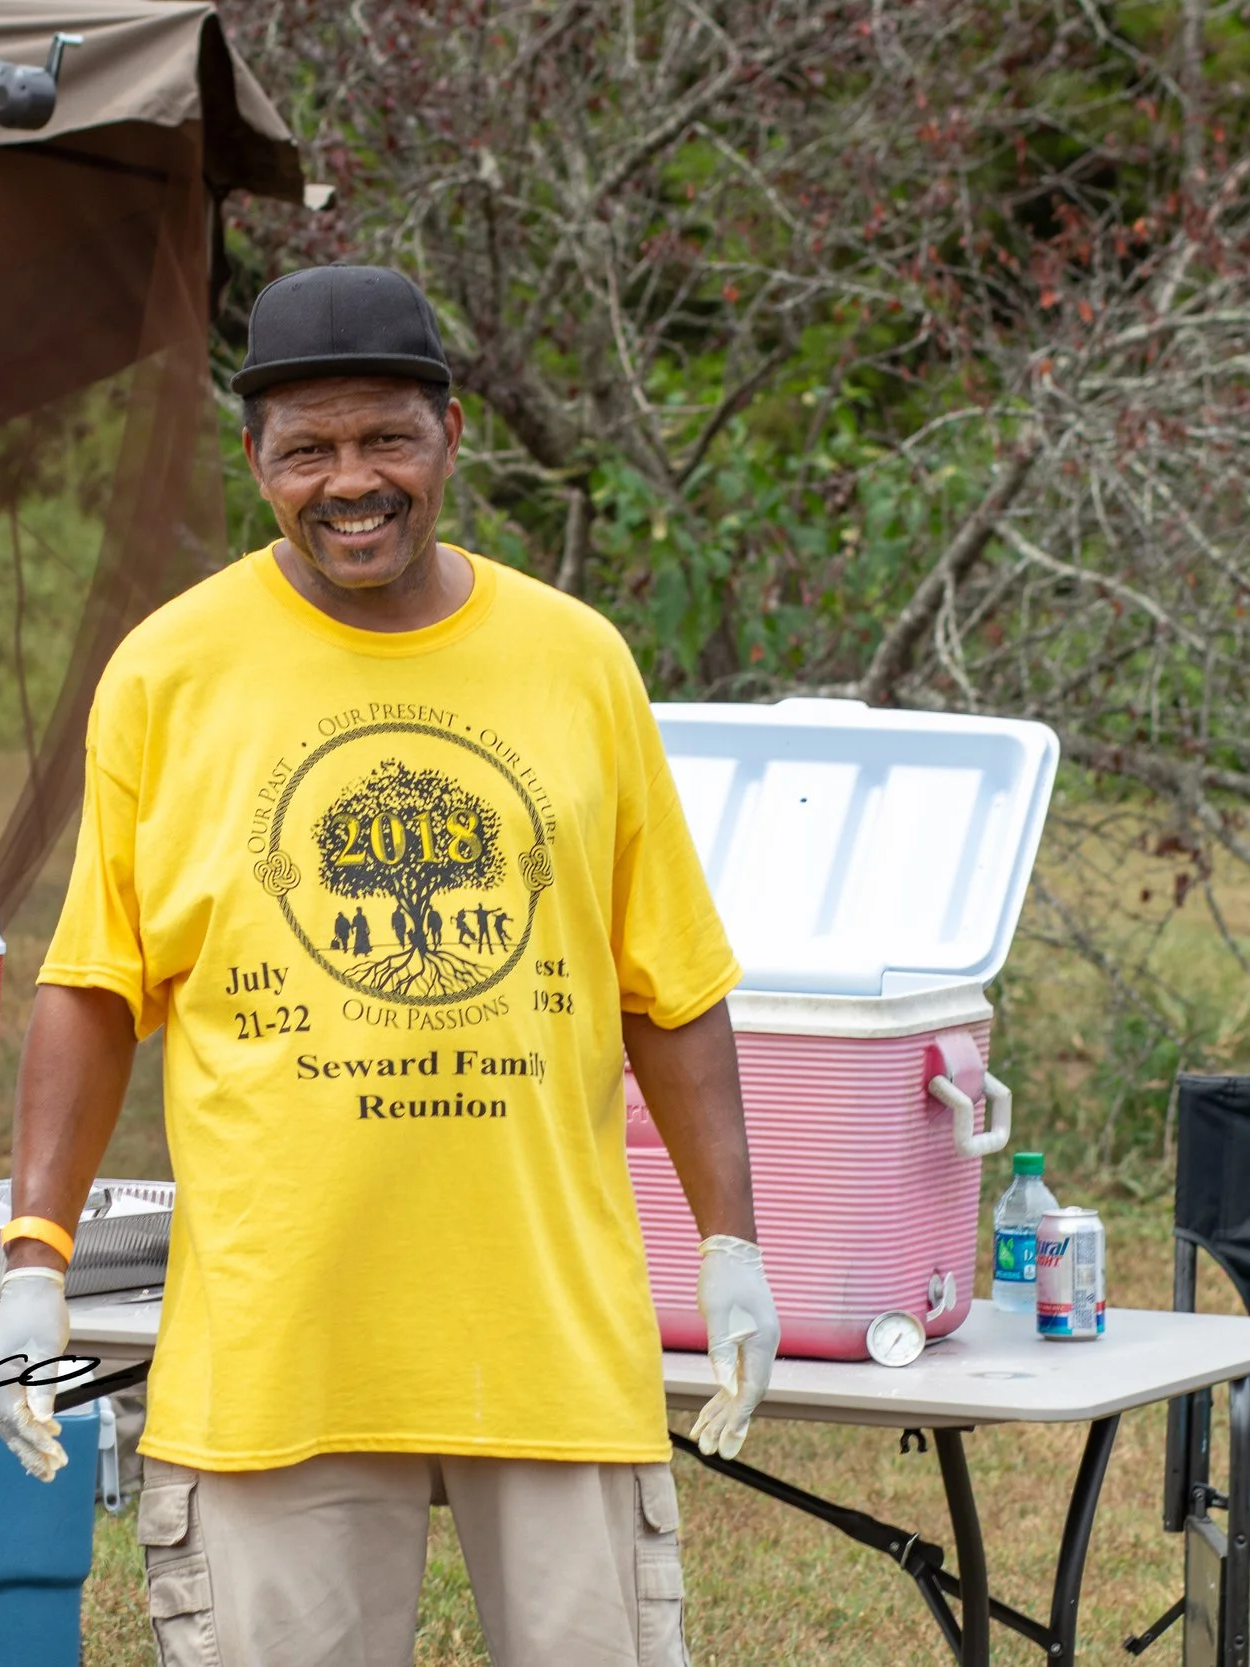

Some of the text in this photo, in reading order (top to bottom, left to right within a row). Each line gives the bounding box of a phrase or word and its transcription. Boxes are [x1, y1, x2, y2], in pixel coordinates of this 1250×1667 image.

[317, 702, 459, 737] OUR PRESENT
[479, 728, 557, 846] OUR FUTURE
[247, 757, 293, 854] OUR PAST
[331, 808, 484, 867] 2018
[225, 961, 289, 996] July
[535, 956, 570, 978] est.
[342, 994, 510, 1031] OUR PASSIONS
[533, 988, 575, 1015] 1938
[235, 1004, 311, 1040] 21-22
[296, 1049, 548, 1085] Seward Family
[356, 1091, 509, 1121] Reunion
